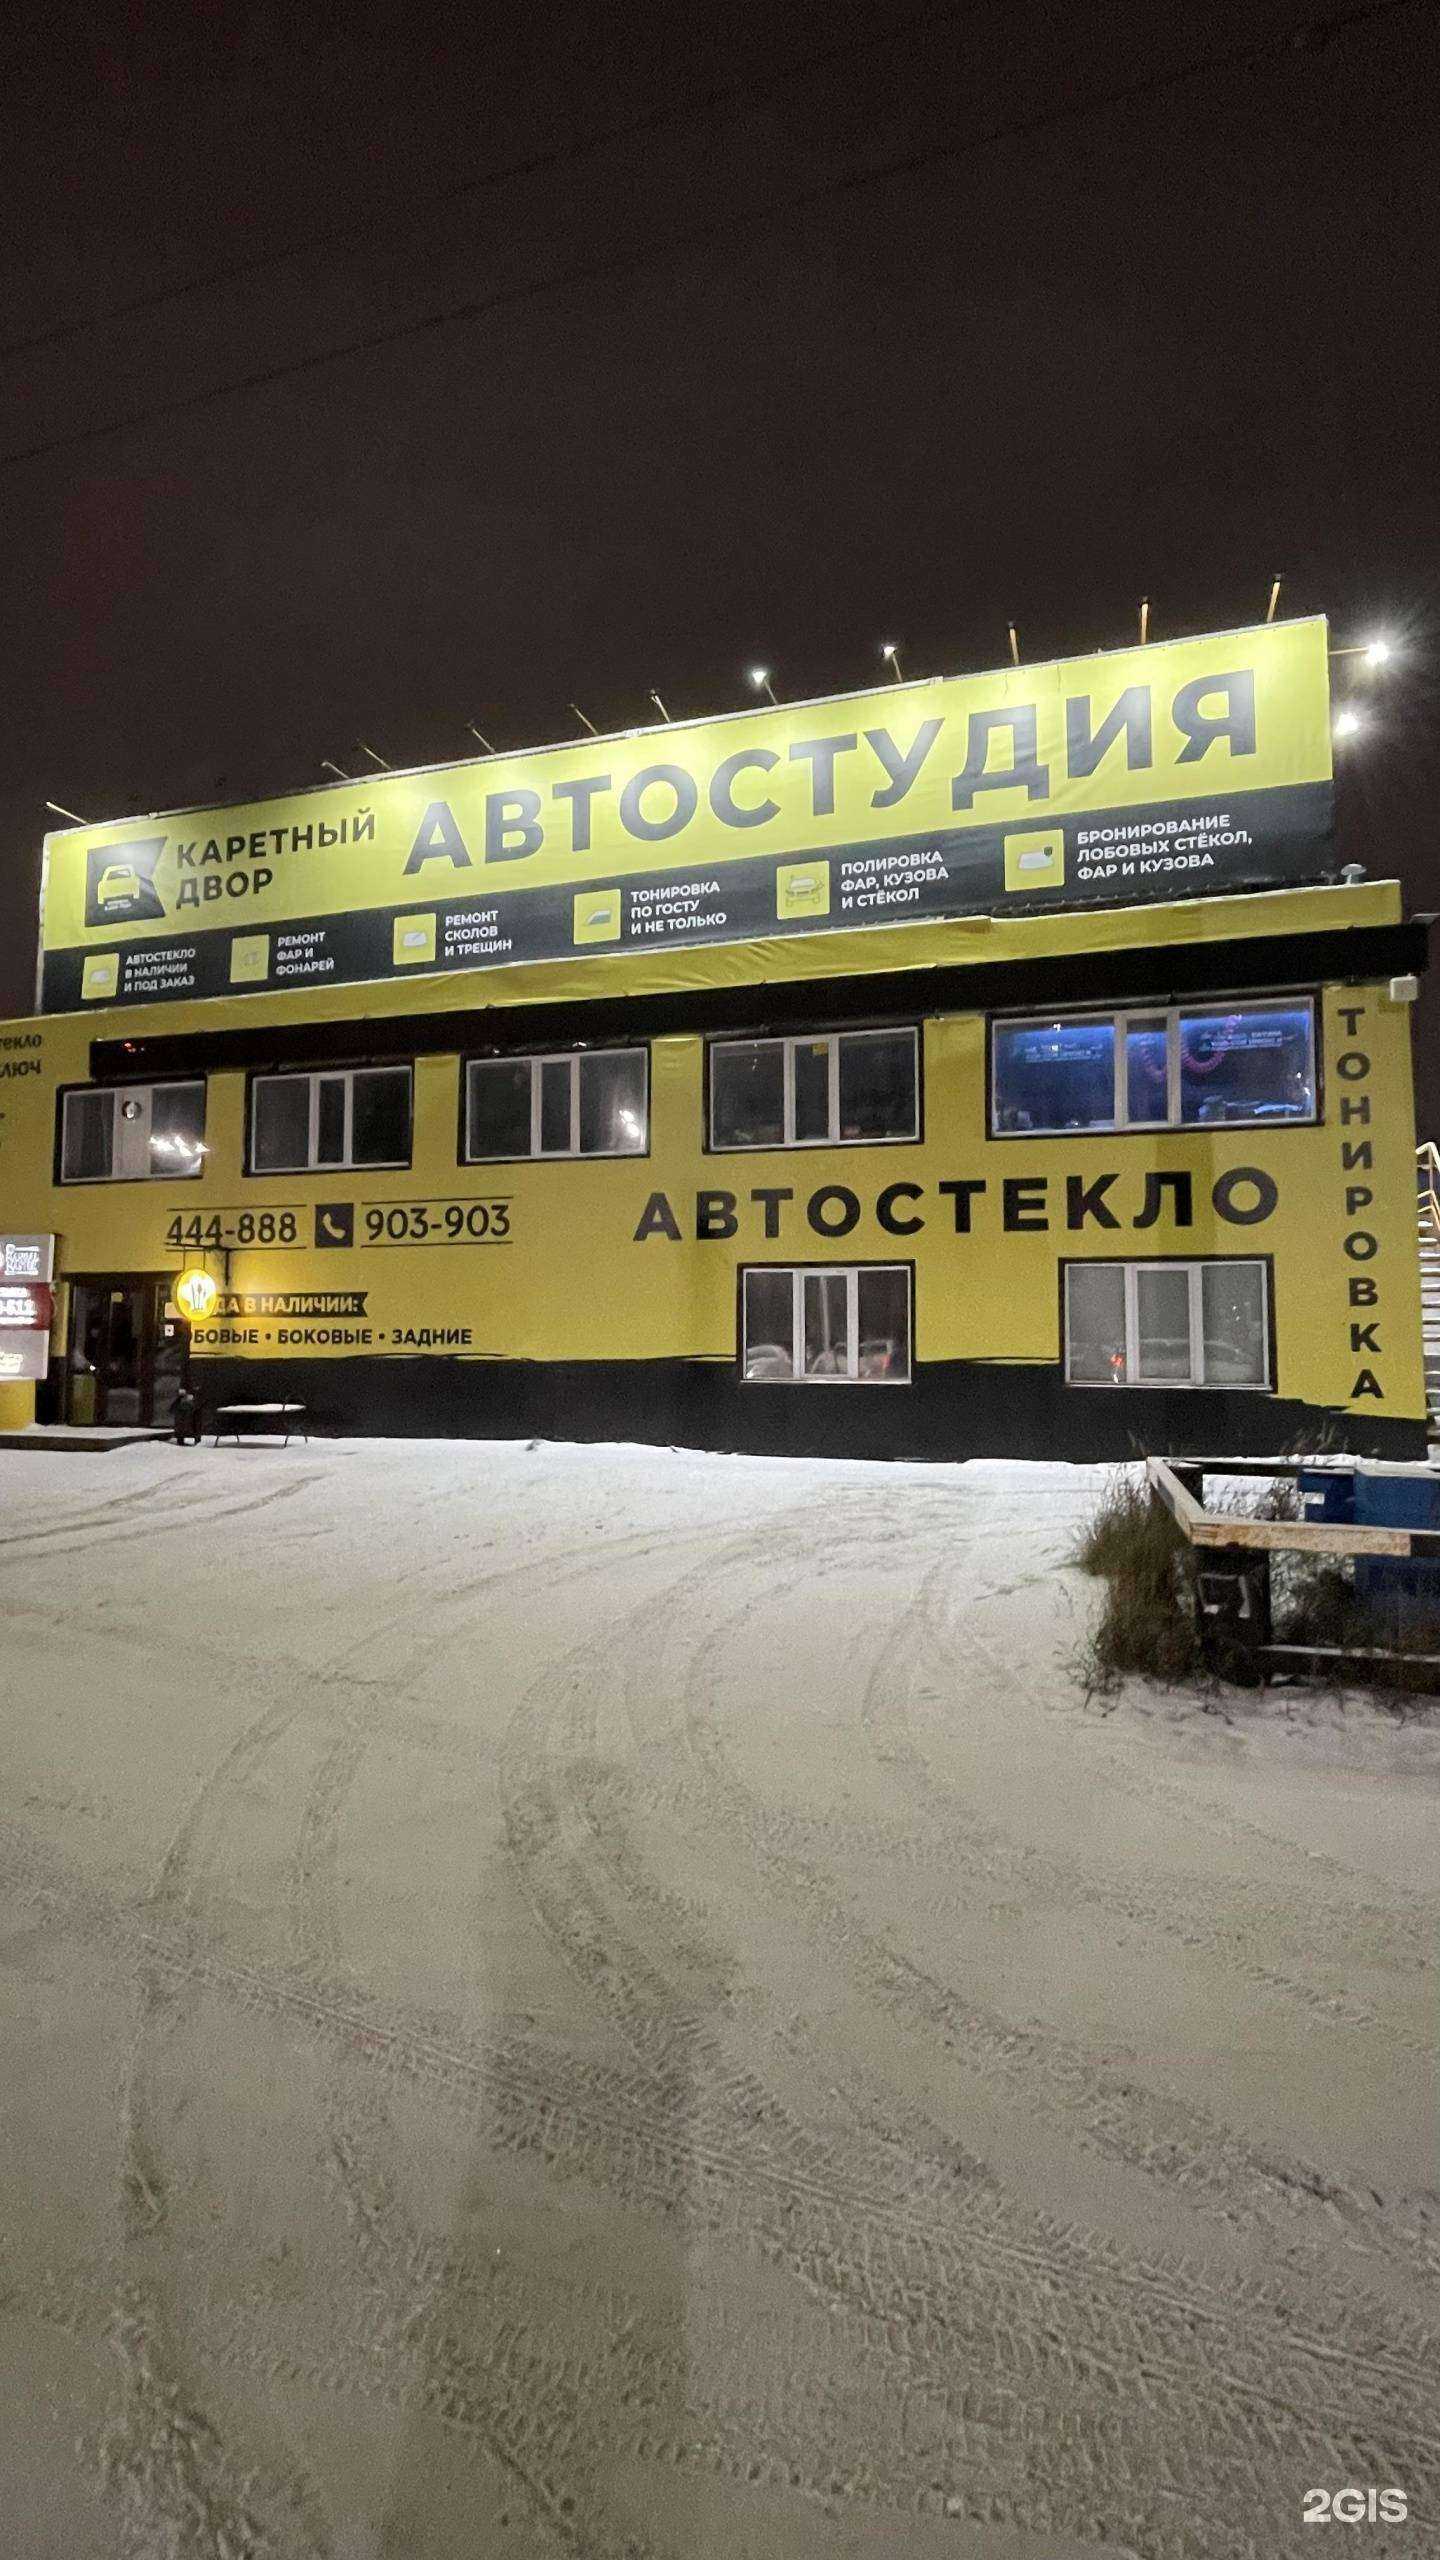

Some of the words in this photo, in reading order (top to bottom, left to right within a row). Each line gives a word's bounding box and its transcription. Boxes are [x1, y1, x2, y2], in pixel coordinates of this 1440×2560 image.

[402, 669, 1256, 876] АВТОСТУДИЯ
[177, 807, 375, 869] КАРЕТНЫЙ
[1077, 814, 1231, 845] БРОНИРОВАНИЕ
[1076, 840, 1169, 863] ЛОБОВЫХ
[1173, 830, 1252, 855] СТЁКОЛ,
[841, 850, 943, 875] ПОЛИРОВКА
[1078, 864, 1118, 880] ФАР
[1122, 862, 1135, 875] И
[1139, 854, 1214, 874] КУЗОВА
[175, 867, 273, 911] ДВОР
[840, 876, 881, 893] ФАР,
[883, 866, 949, 887] КУЗОВА
[631, 881, 720, 903] ТОНИРОВКА
[841, 896, 853, 909] И
[856, 886, 920, 905] СТЁКОЛ
[445, 910, 498, 927] РЕМОНТ
[631, 905, 652, 918] ПО
[655, 899, 700, 915] ГОСТУ
[444, 925, 498, 942] СКОЛОВ
[631, 922, 642, 935] И
[645, 918, 664, 933] НЕ
[667, 912, 727, 931] ТОЛЬКО
[277, 931, 326, 947] РЕМОНТ
[445, 945, 454, 957] И
[457, 938, 512, 956] ТРЕЩИН
[125, 948, 196, 965] АВТОСТЕКЛО
[276, 949, 302, 961] ФАР
[304, 947, 314, 958] И
[134, 963, 188, 979] НАЛИЧИИ
[275, 957, 335, 976] ФОНАРЕЙ
[124, 981, 132, 992] И
[134, 978, 158, 991] ПОД
[160, 976, 195, 989] ЗАКАЗ
[633, 1166, 1279, 1242] АВТОСТЕКЛО
[1336, 1007, 1385, 1400] ТОНИРОВКА
[166, 1212, 298, 1244] 444-888
[365, 1204, 511, 1241] 903-903
[262, 1295, 359, 1314] НАЛИЧИИ:
[191, 1328, 259, 1345] БОВЫЕ
[278, 1328, 372, 1346] БОКОВЫЕ
[391, 1328, 472, 1346] ЗАДНИЕ
